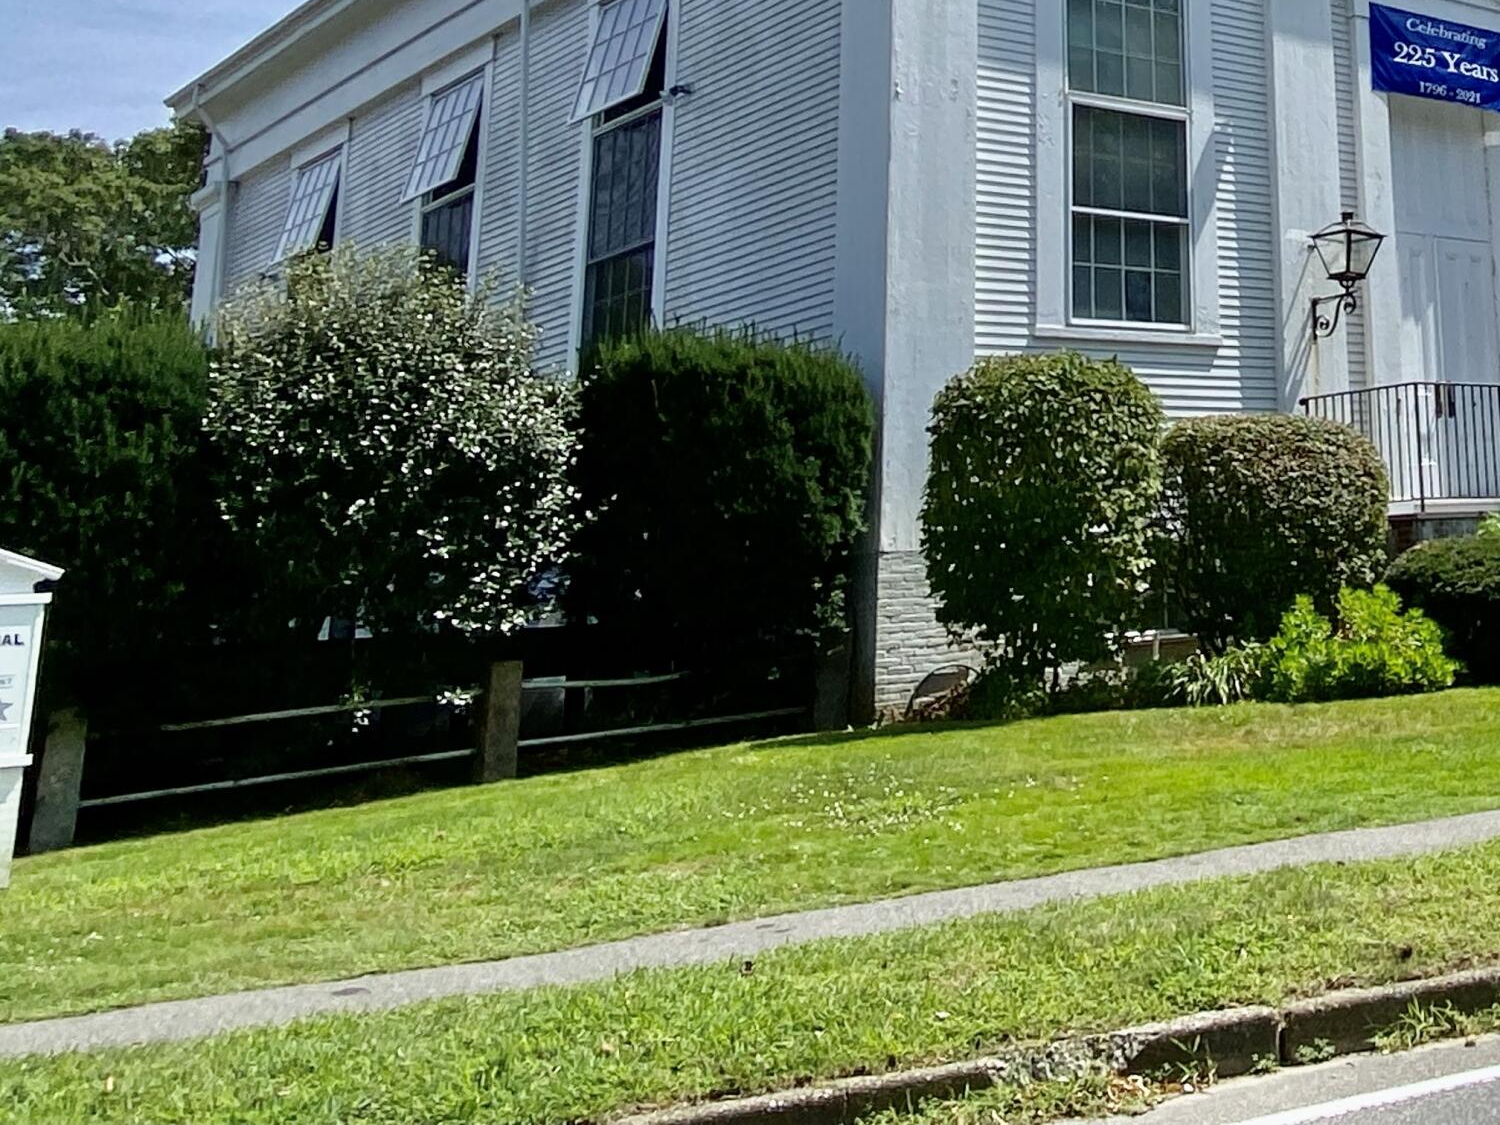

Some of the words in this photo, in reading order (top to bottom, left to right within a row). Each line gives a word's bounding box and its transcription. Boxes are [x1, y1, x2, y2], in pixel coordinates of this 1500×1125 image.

[1406, 17, 1488, 50] Celebrating
[1393, 41, 1436, 68] 225
[1442, 51, 1499, 83] Years
[1419, 81, 1448, 97] 1796
[1456, 88, 1482, 104] 2021
